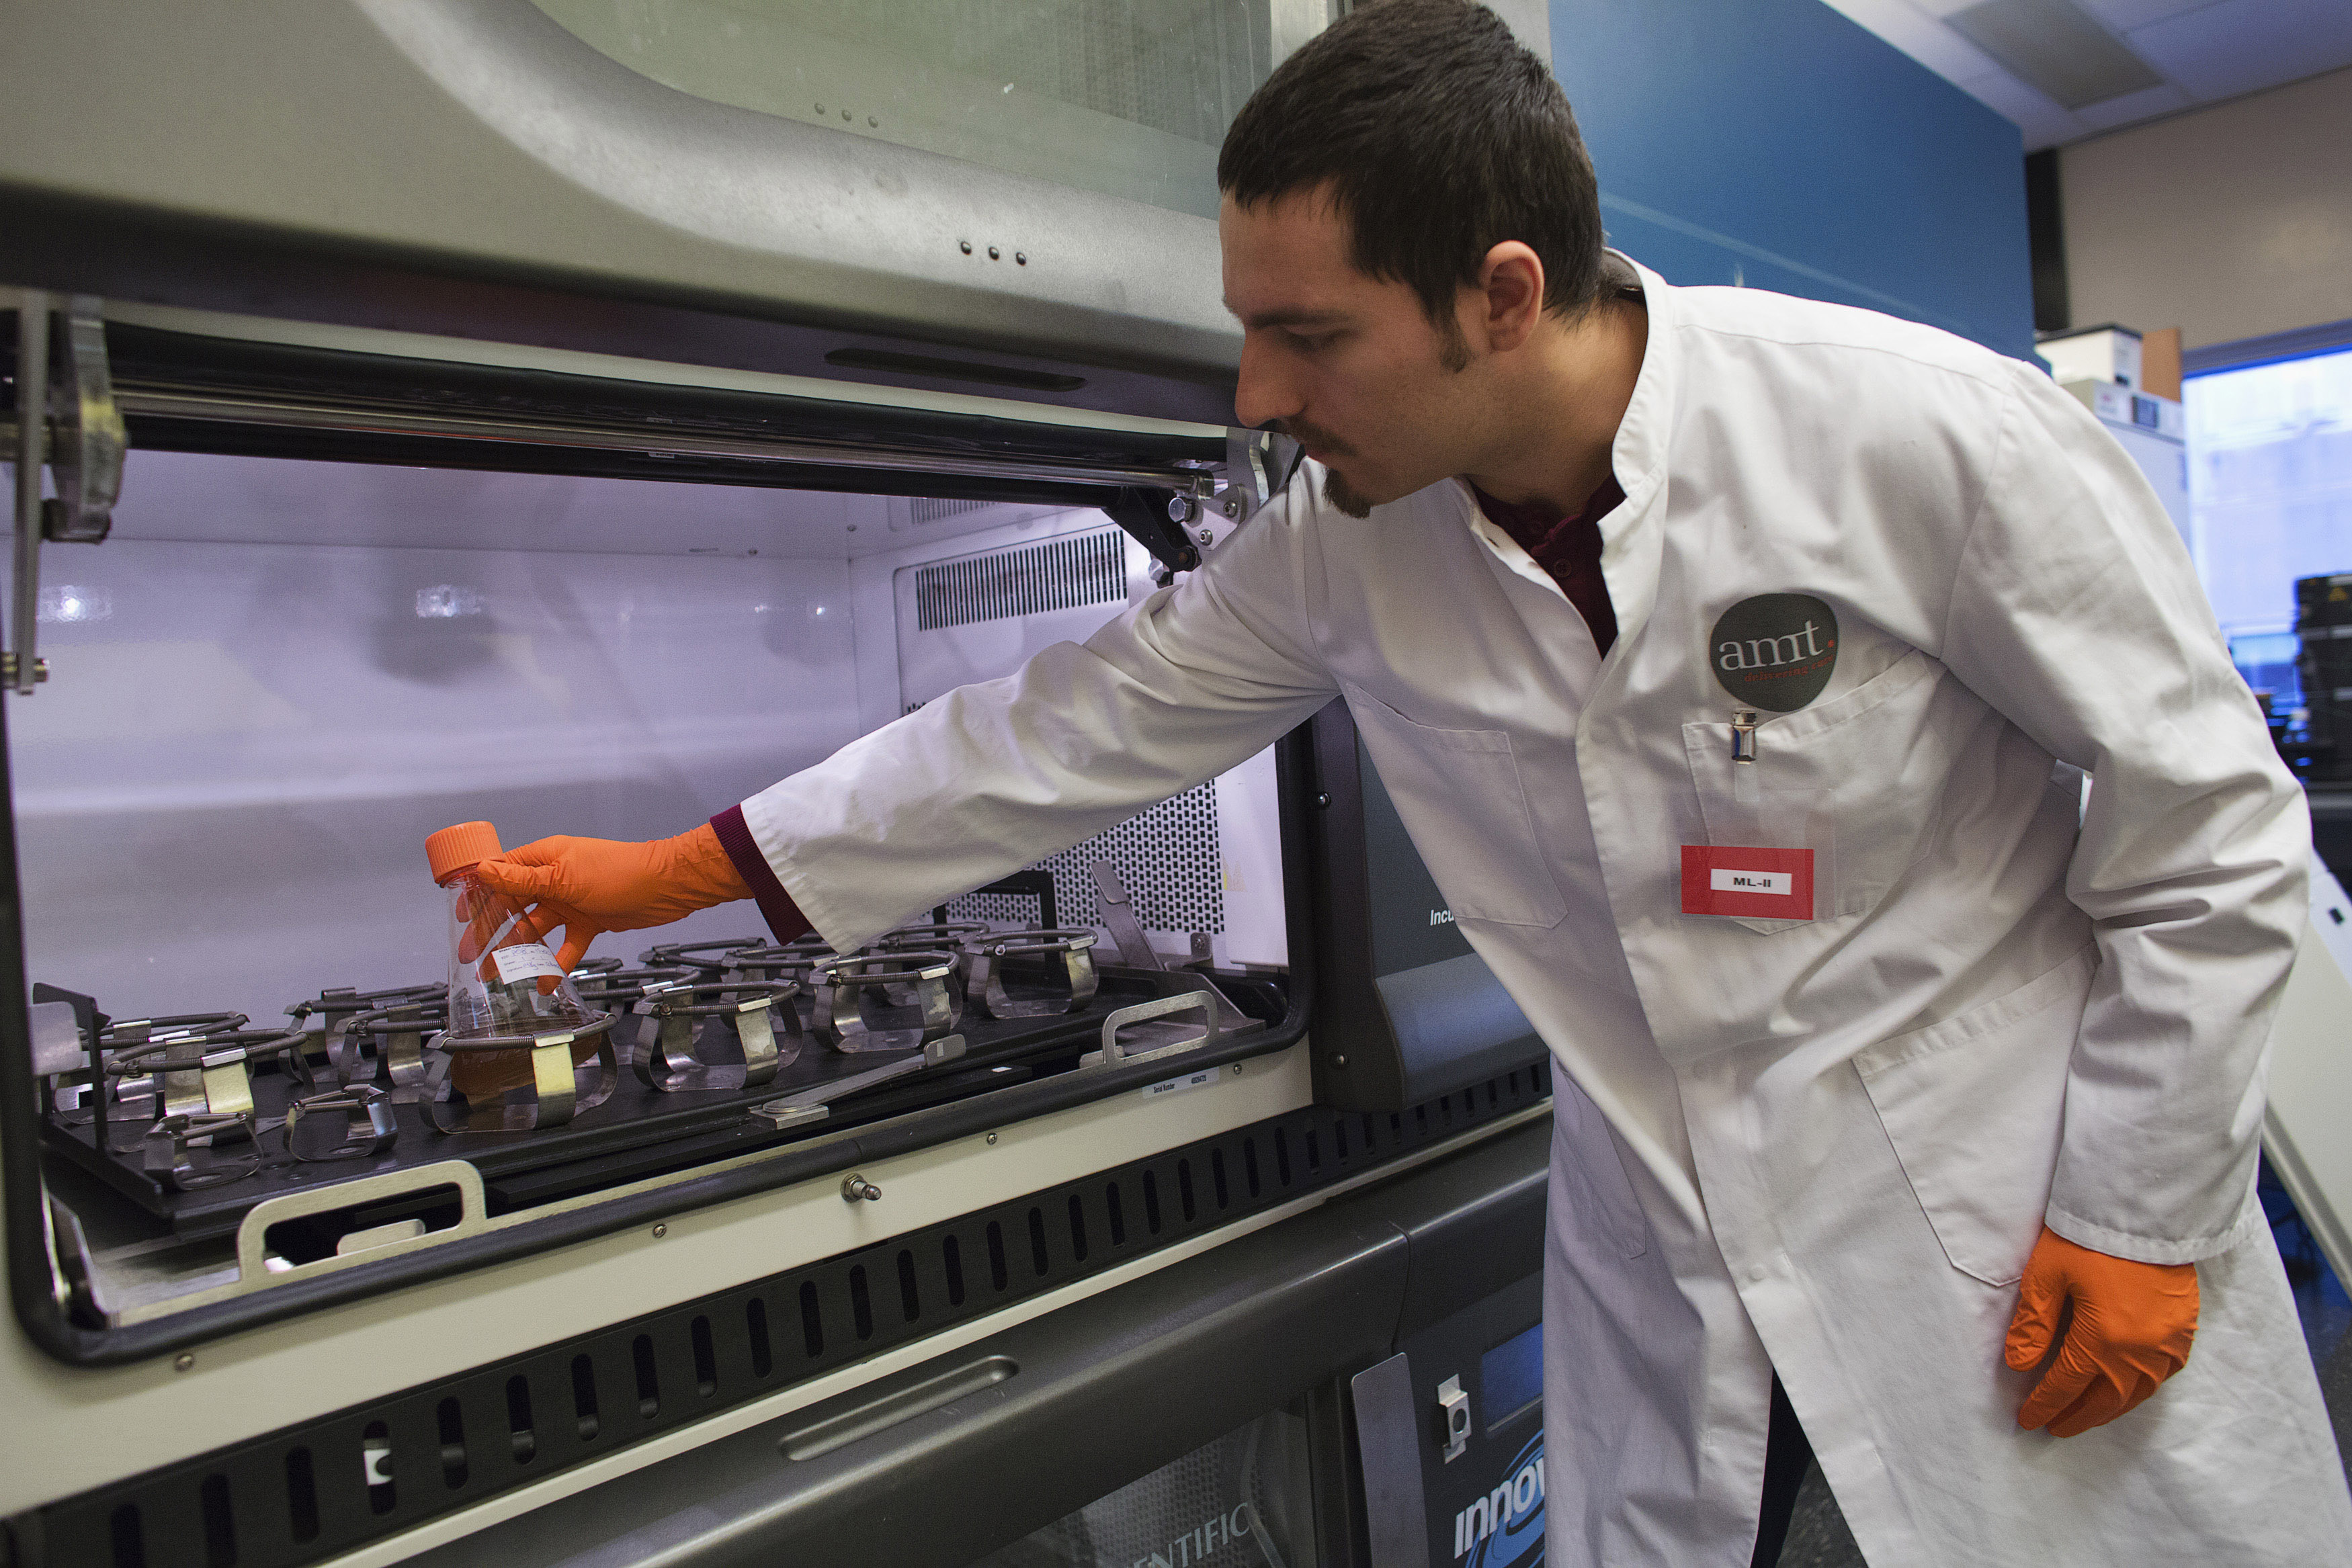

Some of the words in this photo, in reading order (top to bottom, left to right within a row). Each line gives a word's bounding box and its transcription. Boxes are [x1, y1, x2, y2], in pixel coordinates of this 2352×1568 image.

[1733, 877, 1771, 887] ML-II
[1154, 1085, 1162, 1093] Serial
[1163, 1083, 1175, 1091] Number
